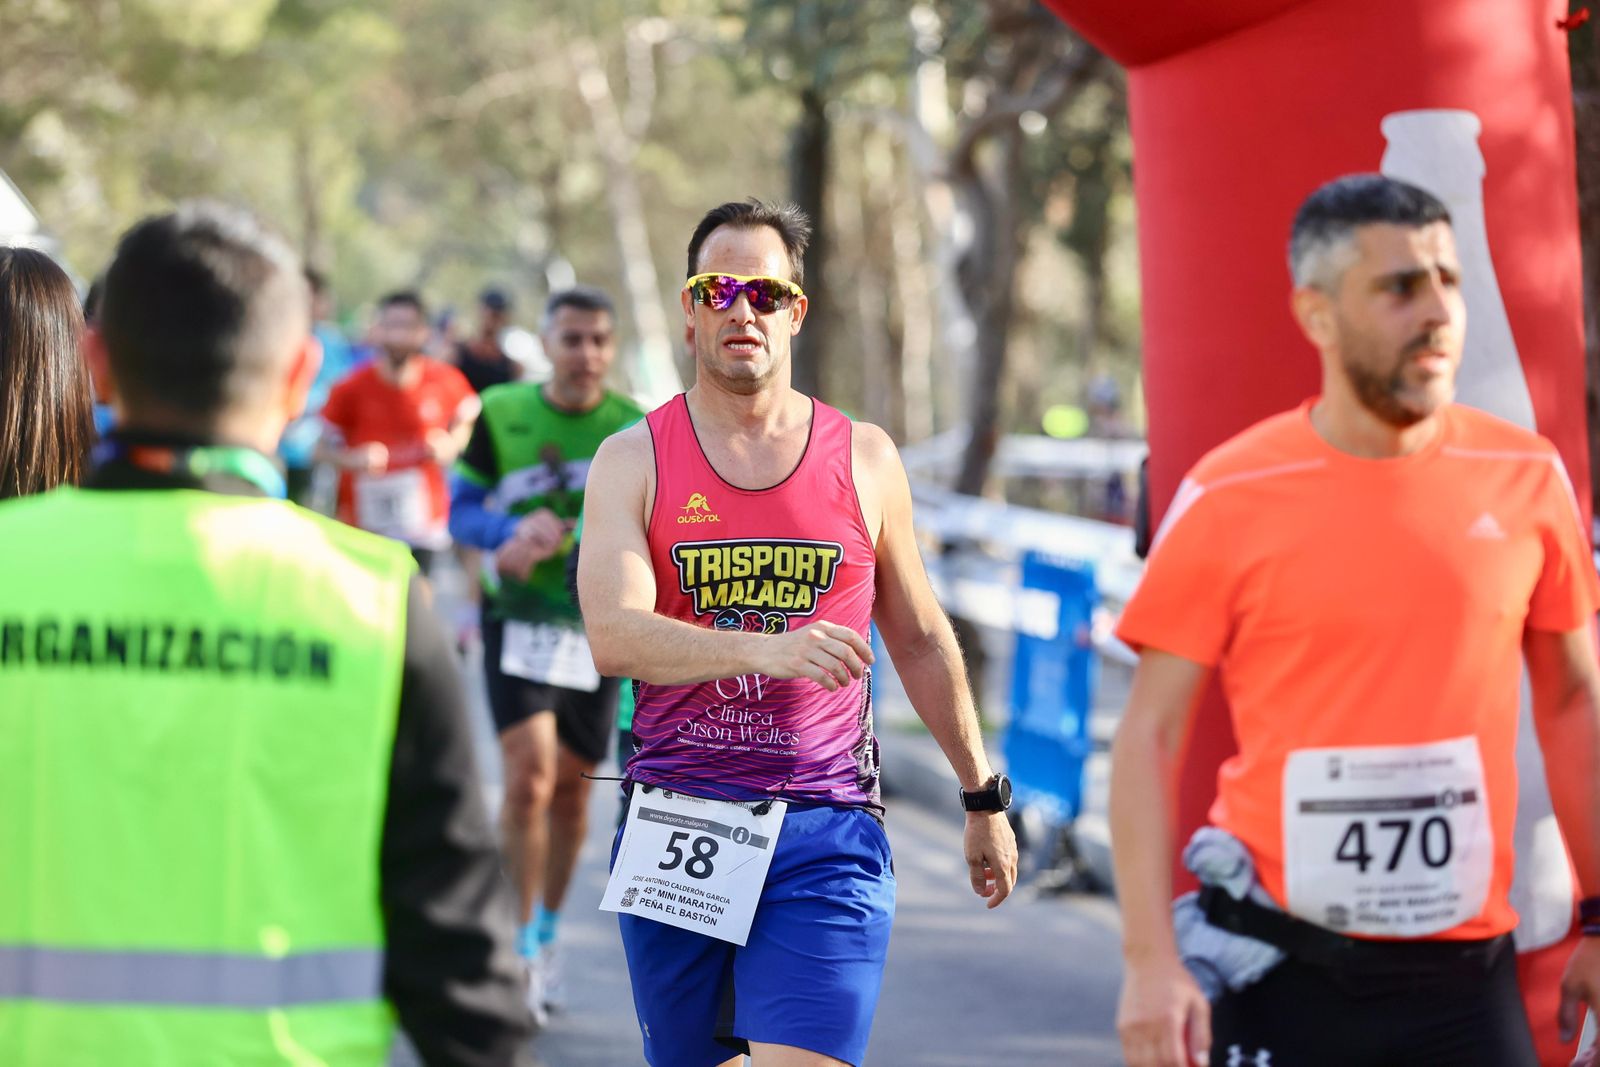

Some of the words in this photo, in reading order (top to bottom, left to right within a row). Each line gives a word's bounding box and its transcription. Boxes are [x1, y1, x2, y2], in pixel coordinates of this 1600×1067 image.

[677, 513, 721, 524] austral
[679, 545, 837, 587] TRISPORT
[699, 579, 812, 610] MALAGA
[706, 704, 773, 726] Clínica
[658, 831, 719, 880] 58
[1334, 815, 1454, 874] 470
[644, 876, 670, 887] ANTONIO
[671, 882, 705, 897] CALDERÓN
[706, 892, 731, 905] GARCIA
[657, 889, 677, 902] MINI
[678, 895, 725, 915] MARATÓN
[639, 897, 664, 911] PEÑA
[665, 904, 677, 915] EL
[679, 908, 718, 927] BASTÓN
